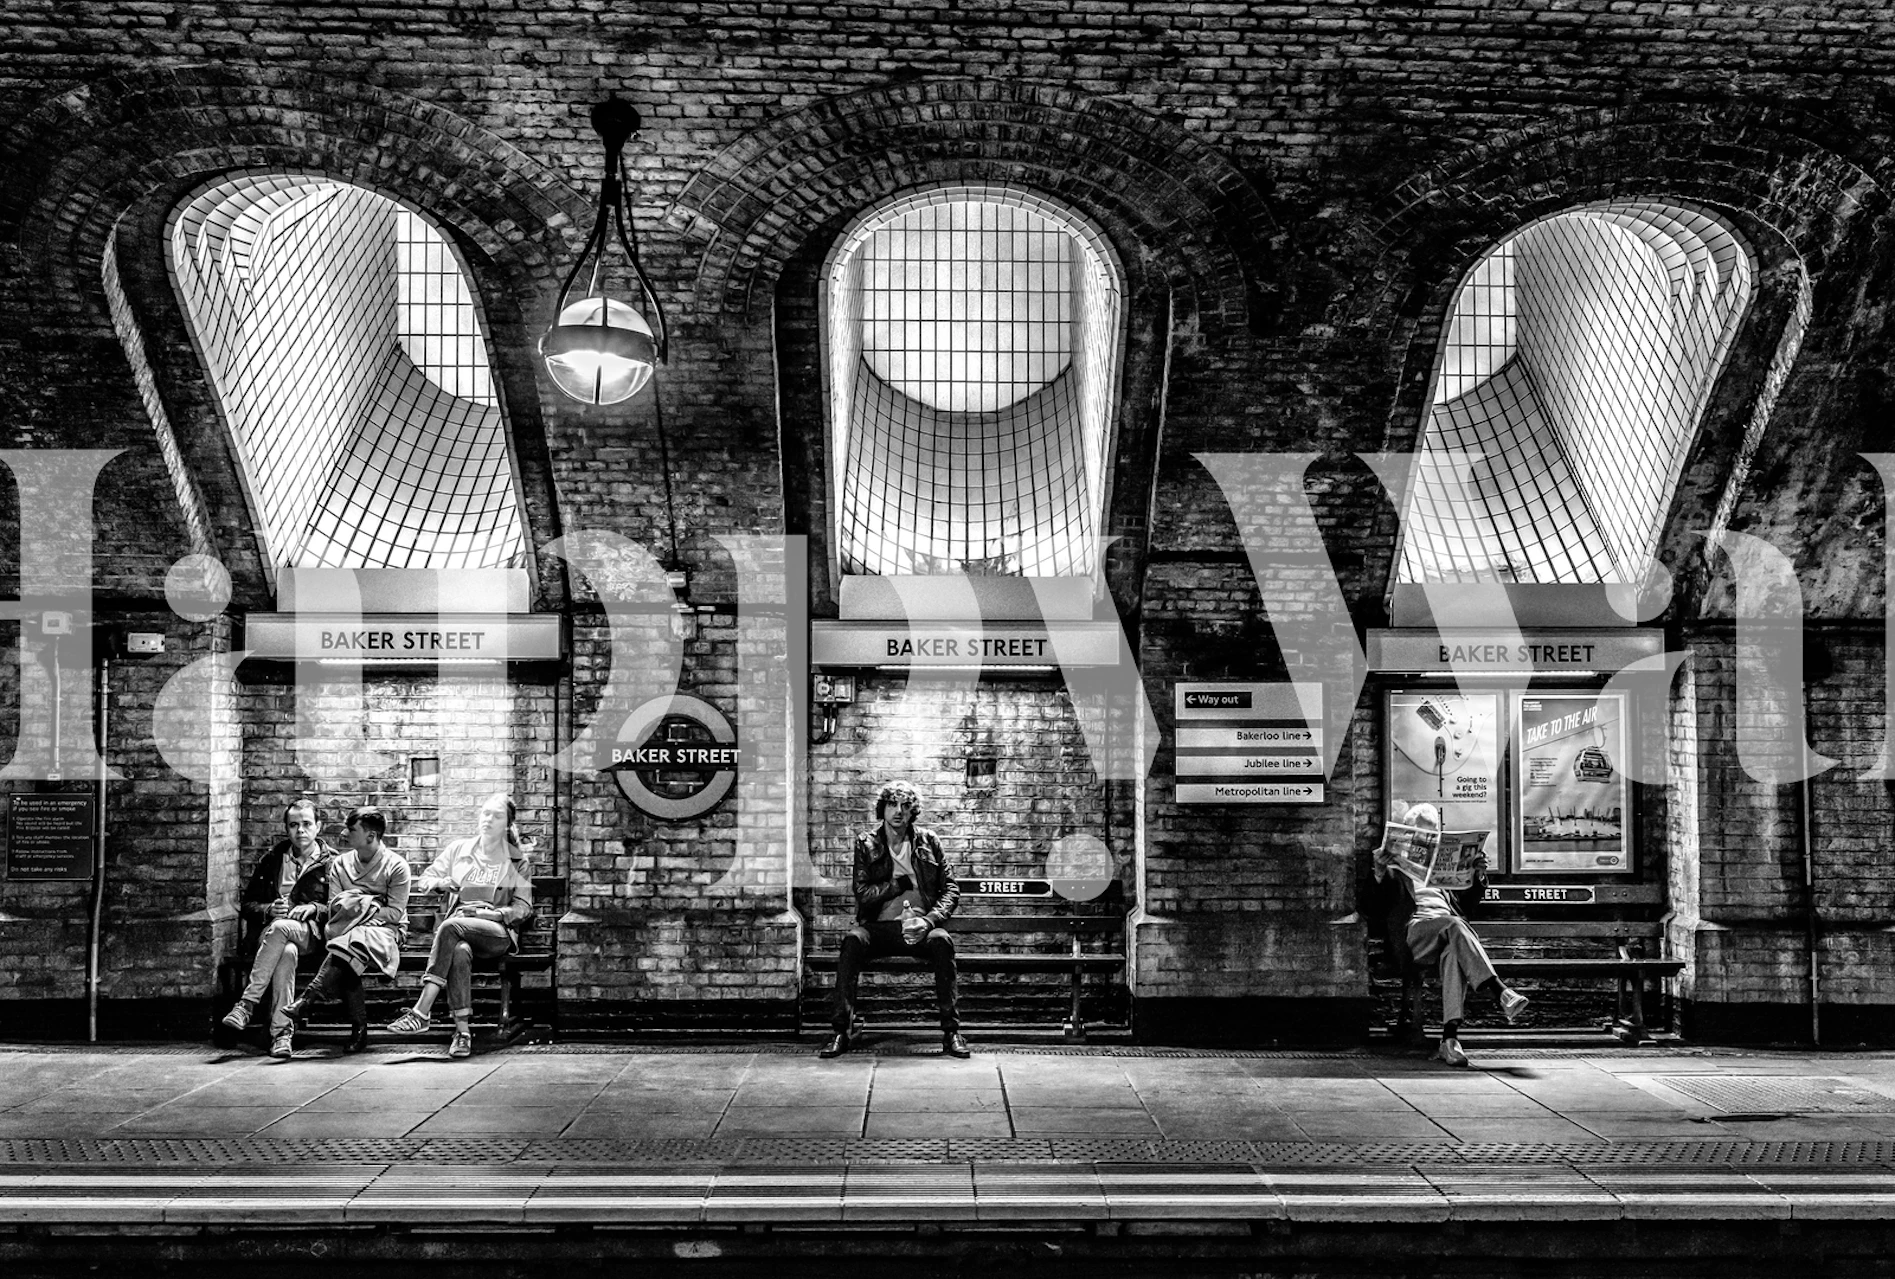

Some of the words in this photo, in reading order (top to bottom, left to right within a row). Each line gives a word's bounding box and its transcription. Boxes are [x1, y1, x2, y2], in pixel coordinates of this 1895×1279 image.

[321, 631, 395, 649] BAKER
[403, 631, 485, 649] STREET
[887, 639, 959, 656] BAKER
[967, 639, 1047, 656] STREET
[1439, 645, 1510, 662] BAKER
[1517, 645, 1594, 662] STREET
[1198, 695, 1219, 706] Way
[1221, 695, 1239, 704] out
[1527, 722, 1549, 744] TAKE
[1550, 718, 1562, 736] TO
[1564, 711, 1581, 731] THE
[1581, 706, 1598, 725] AIR
[1237, 731, 1279, 740] Bakerloo
[1283, 731, 1300, 740] line
[612, 748, 671, 763] BAKER
[676, 748, 742, 763] STREET
[1244, 759, 1279, 768] Jubilee
[1283, 759, 1300, 768] line
[1215, 787, 1279, 798] Metropolitan
[1283, 787, 1300, 796] line
[980, 882, 1025, 893] STREET
[1524, 889, 1567, 900] STREET
